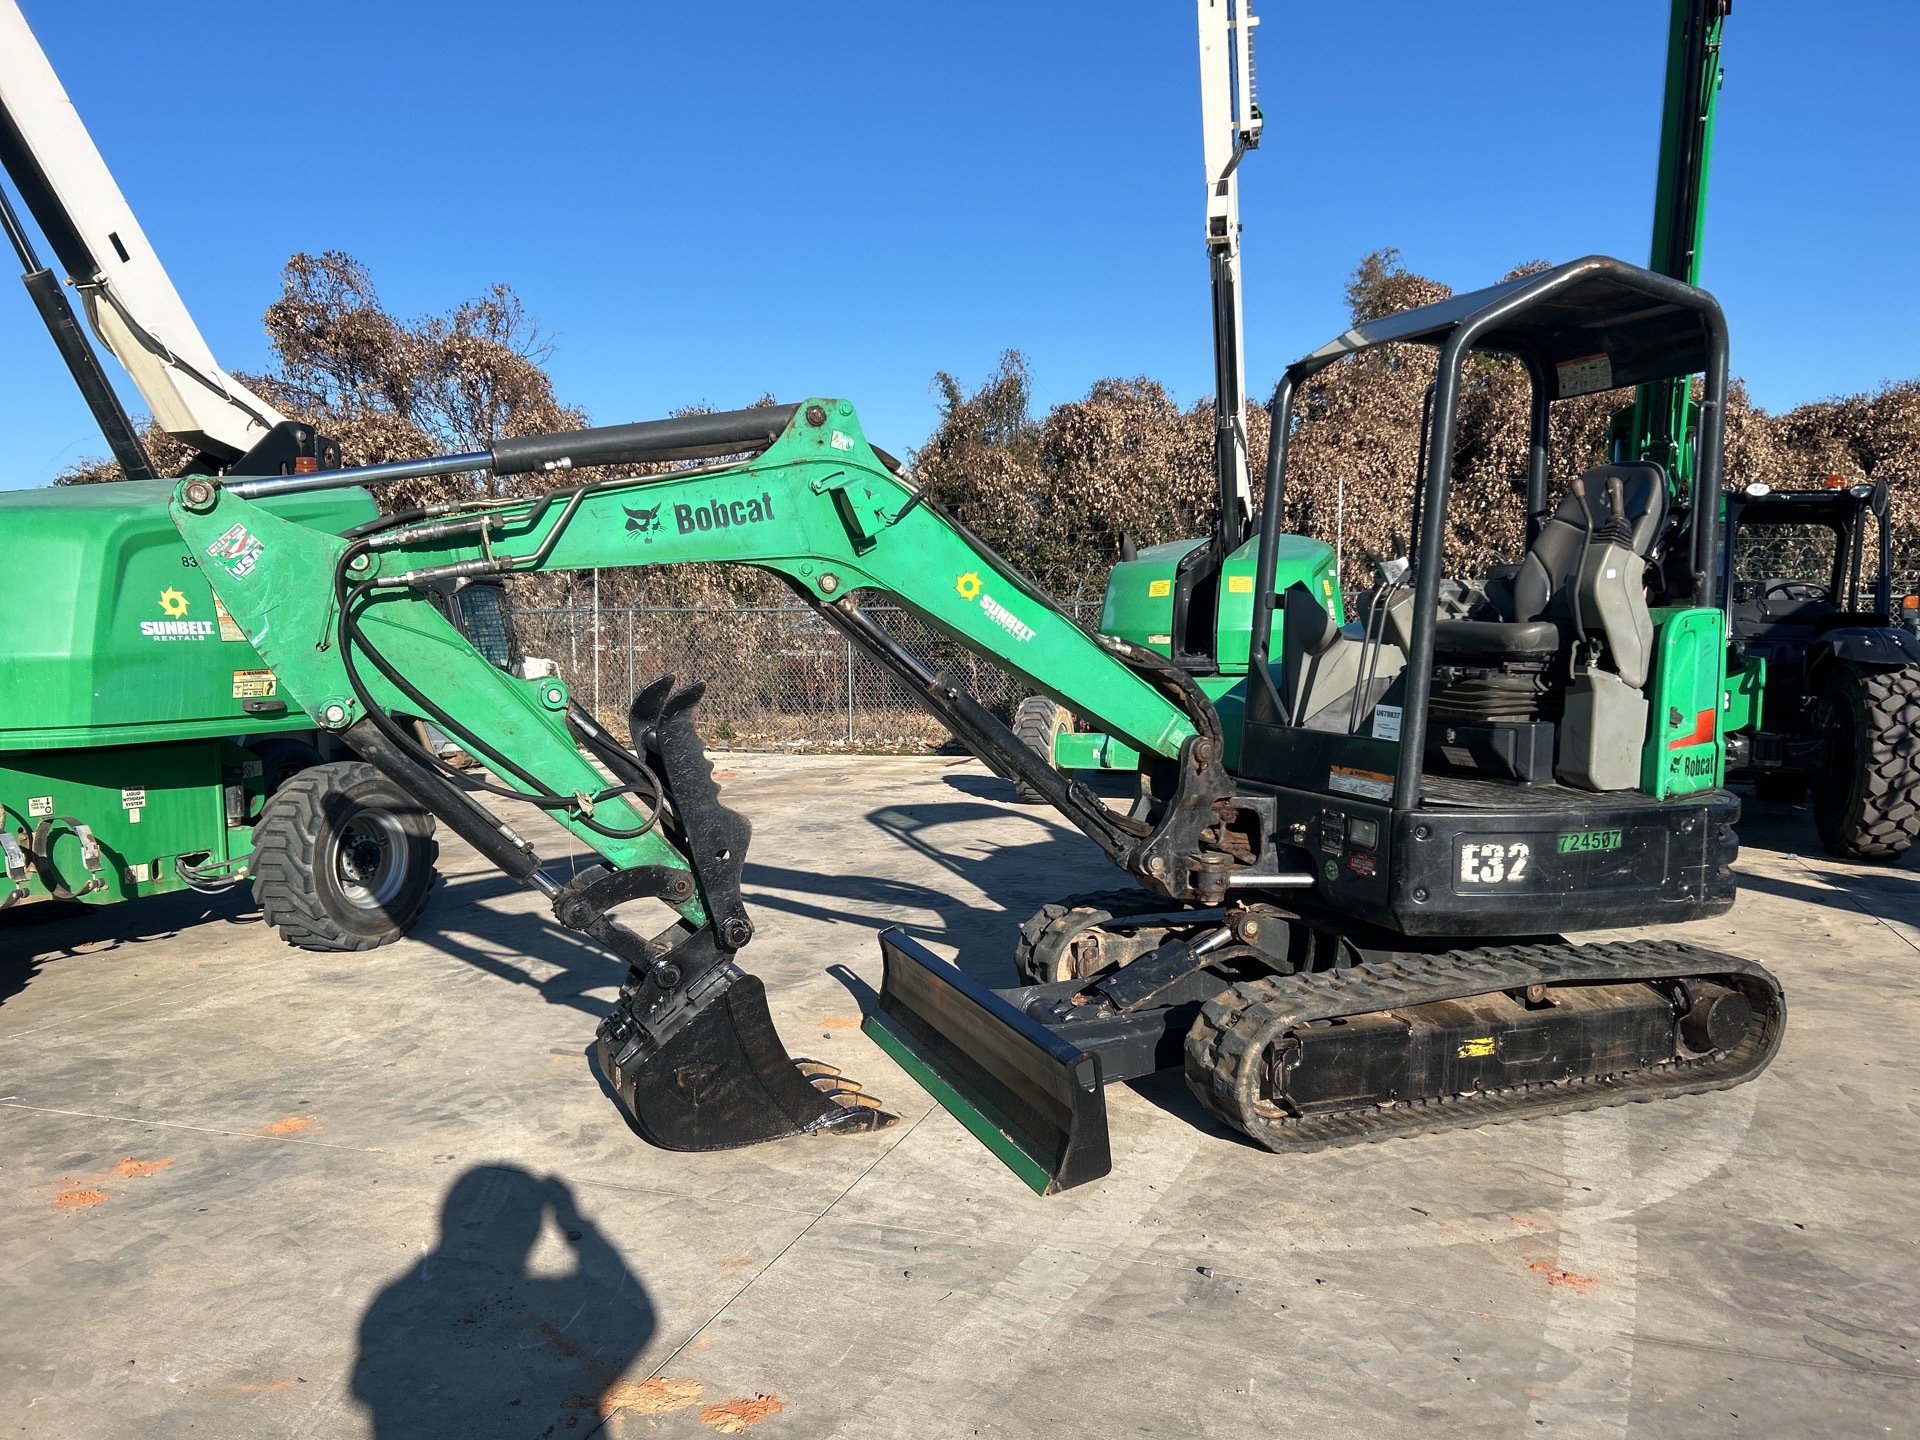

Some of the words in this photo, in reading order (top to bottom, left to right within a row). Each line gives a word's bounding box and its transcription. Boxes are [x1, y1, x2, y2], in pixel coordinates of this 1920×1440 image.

[673, 492, 775, 535] Bobcat
[140, 621, 214, 636] SUNBELT
[979, 593, 1037, 643] SUNBELT
[983, 610, 1022, 642] RENTALS
[1684, 754, 1714, 777] Bobcat
[1559, 830, 1621, 853] 724507
[1460, 842, 1530, 884] E32
